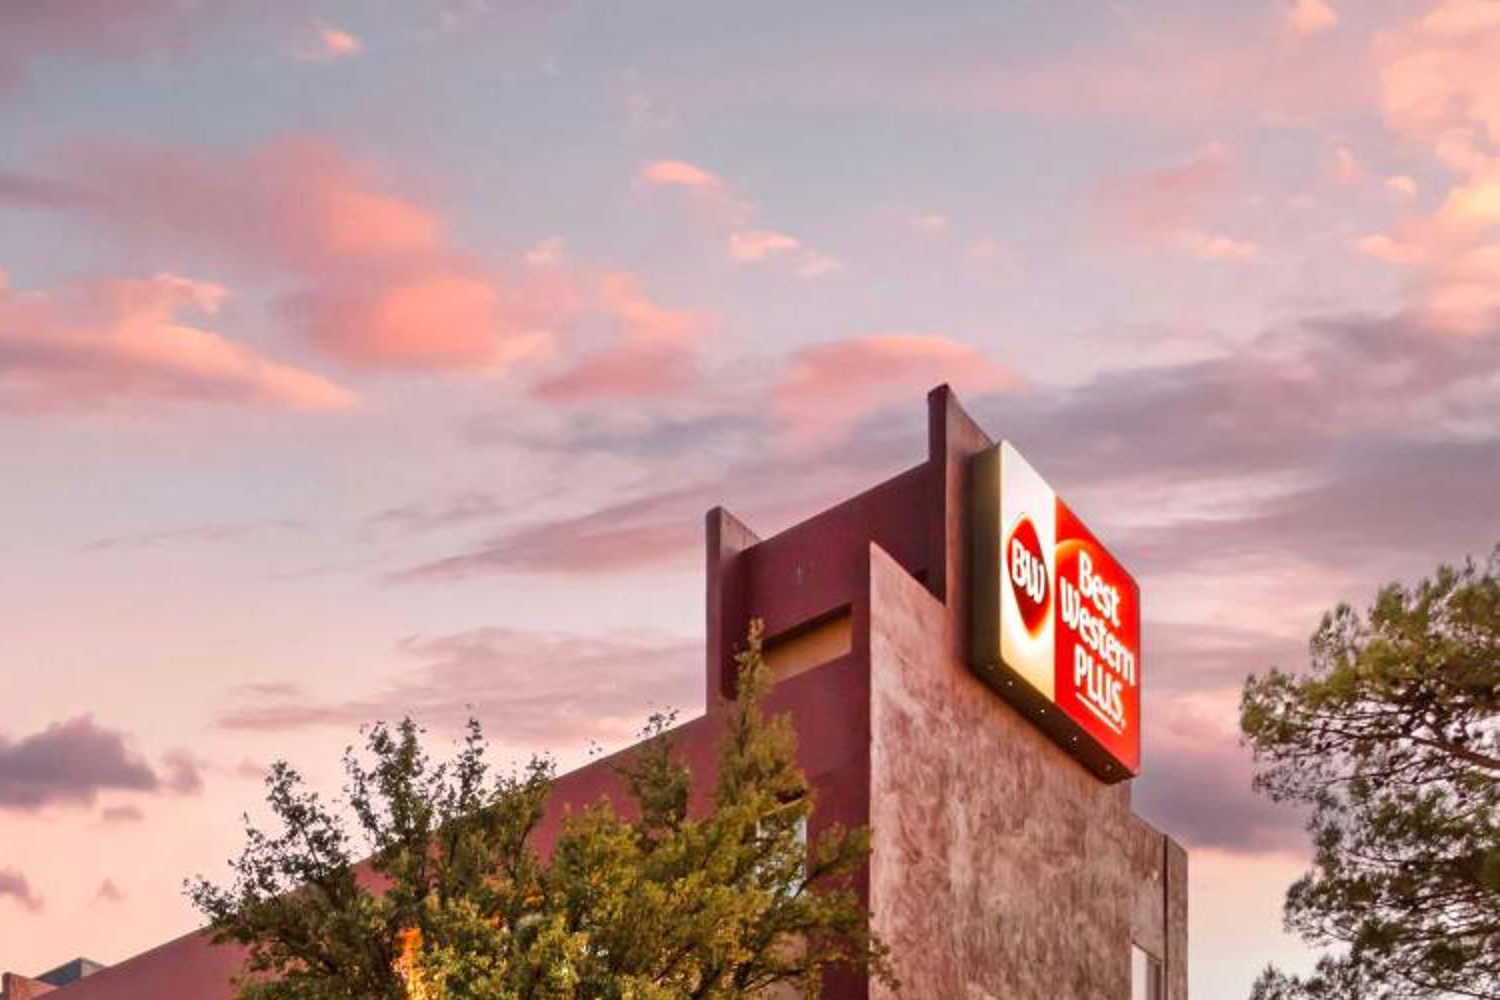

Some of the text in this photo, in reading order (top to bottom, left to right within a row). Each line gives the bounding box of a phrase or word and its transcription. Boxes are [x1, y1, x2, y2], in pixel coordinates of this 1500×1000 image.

[1011, 539, 1045, 605] BW
[1079, 550, 1121, 627] Best
[1060, 578, 1136, 685] Western
